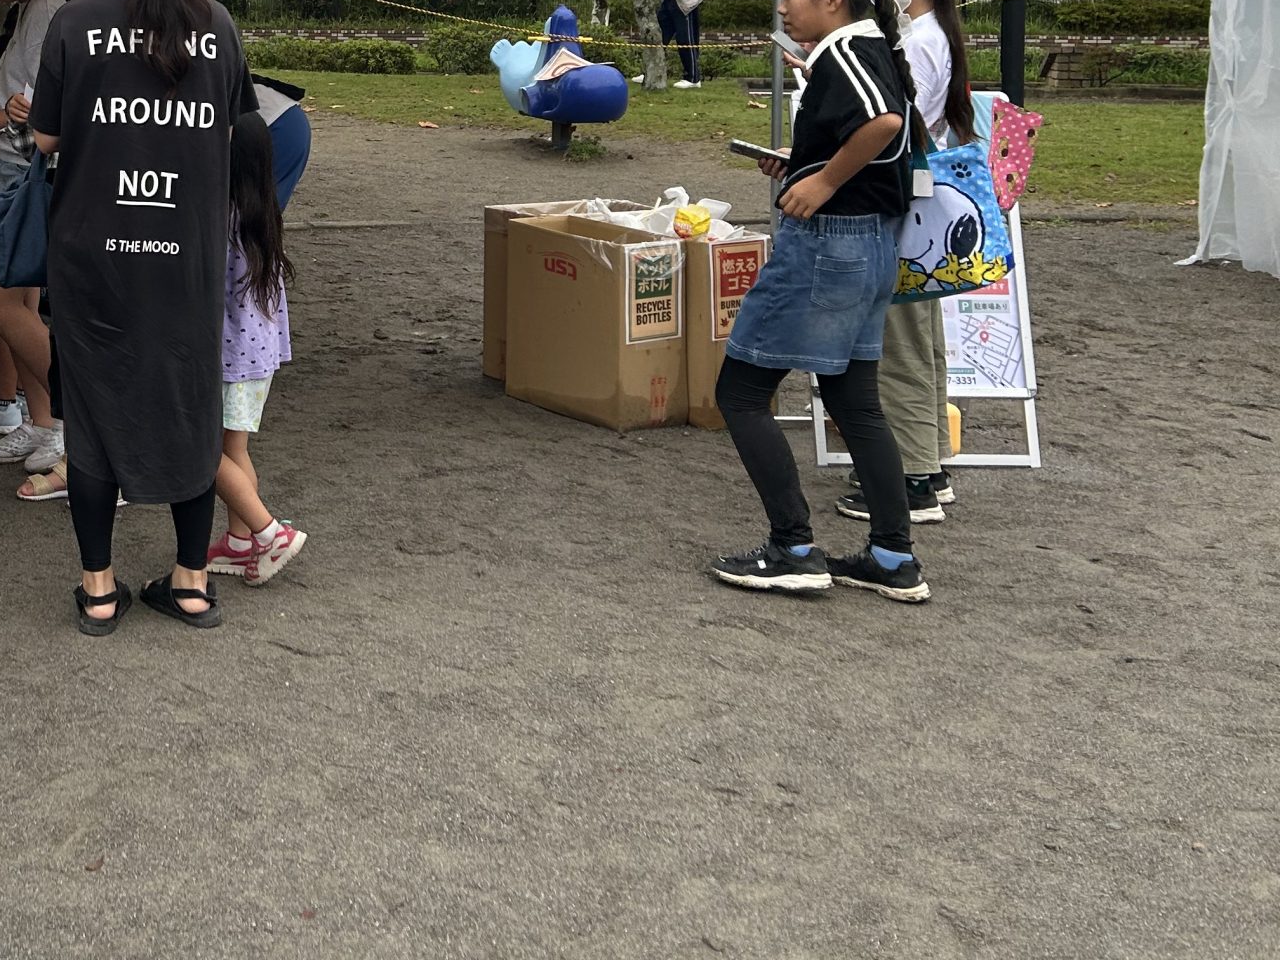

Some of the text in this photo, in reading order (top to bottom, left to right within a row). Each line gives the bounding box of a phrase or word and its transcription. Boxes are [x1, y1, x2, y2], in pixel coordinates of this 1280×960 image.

[91, 97, 215, 129] AROUND
[118, 170, 179, 199] NOT
[105, 238, 180, 255] IS THE MOOD
[722, 258, 757, 275] 燃える
[638, 279, 670, 293] ボトル
[728, 275, 751, 290] ゴミ
[636, 299, 672, 314] RECYCLE
[636, 311, 672, 326] BOTTLES
